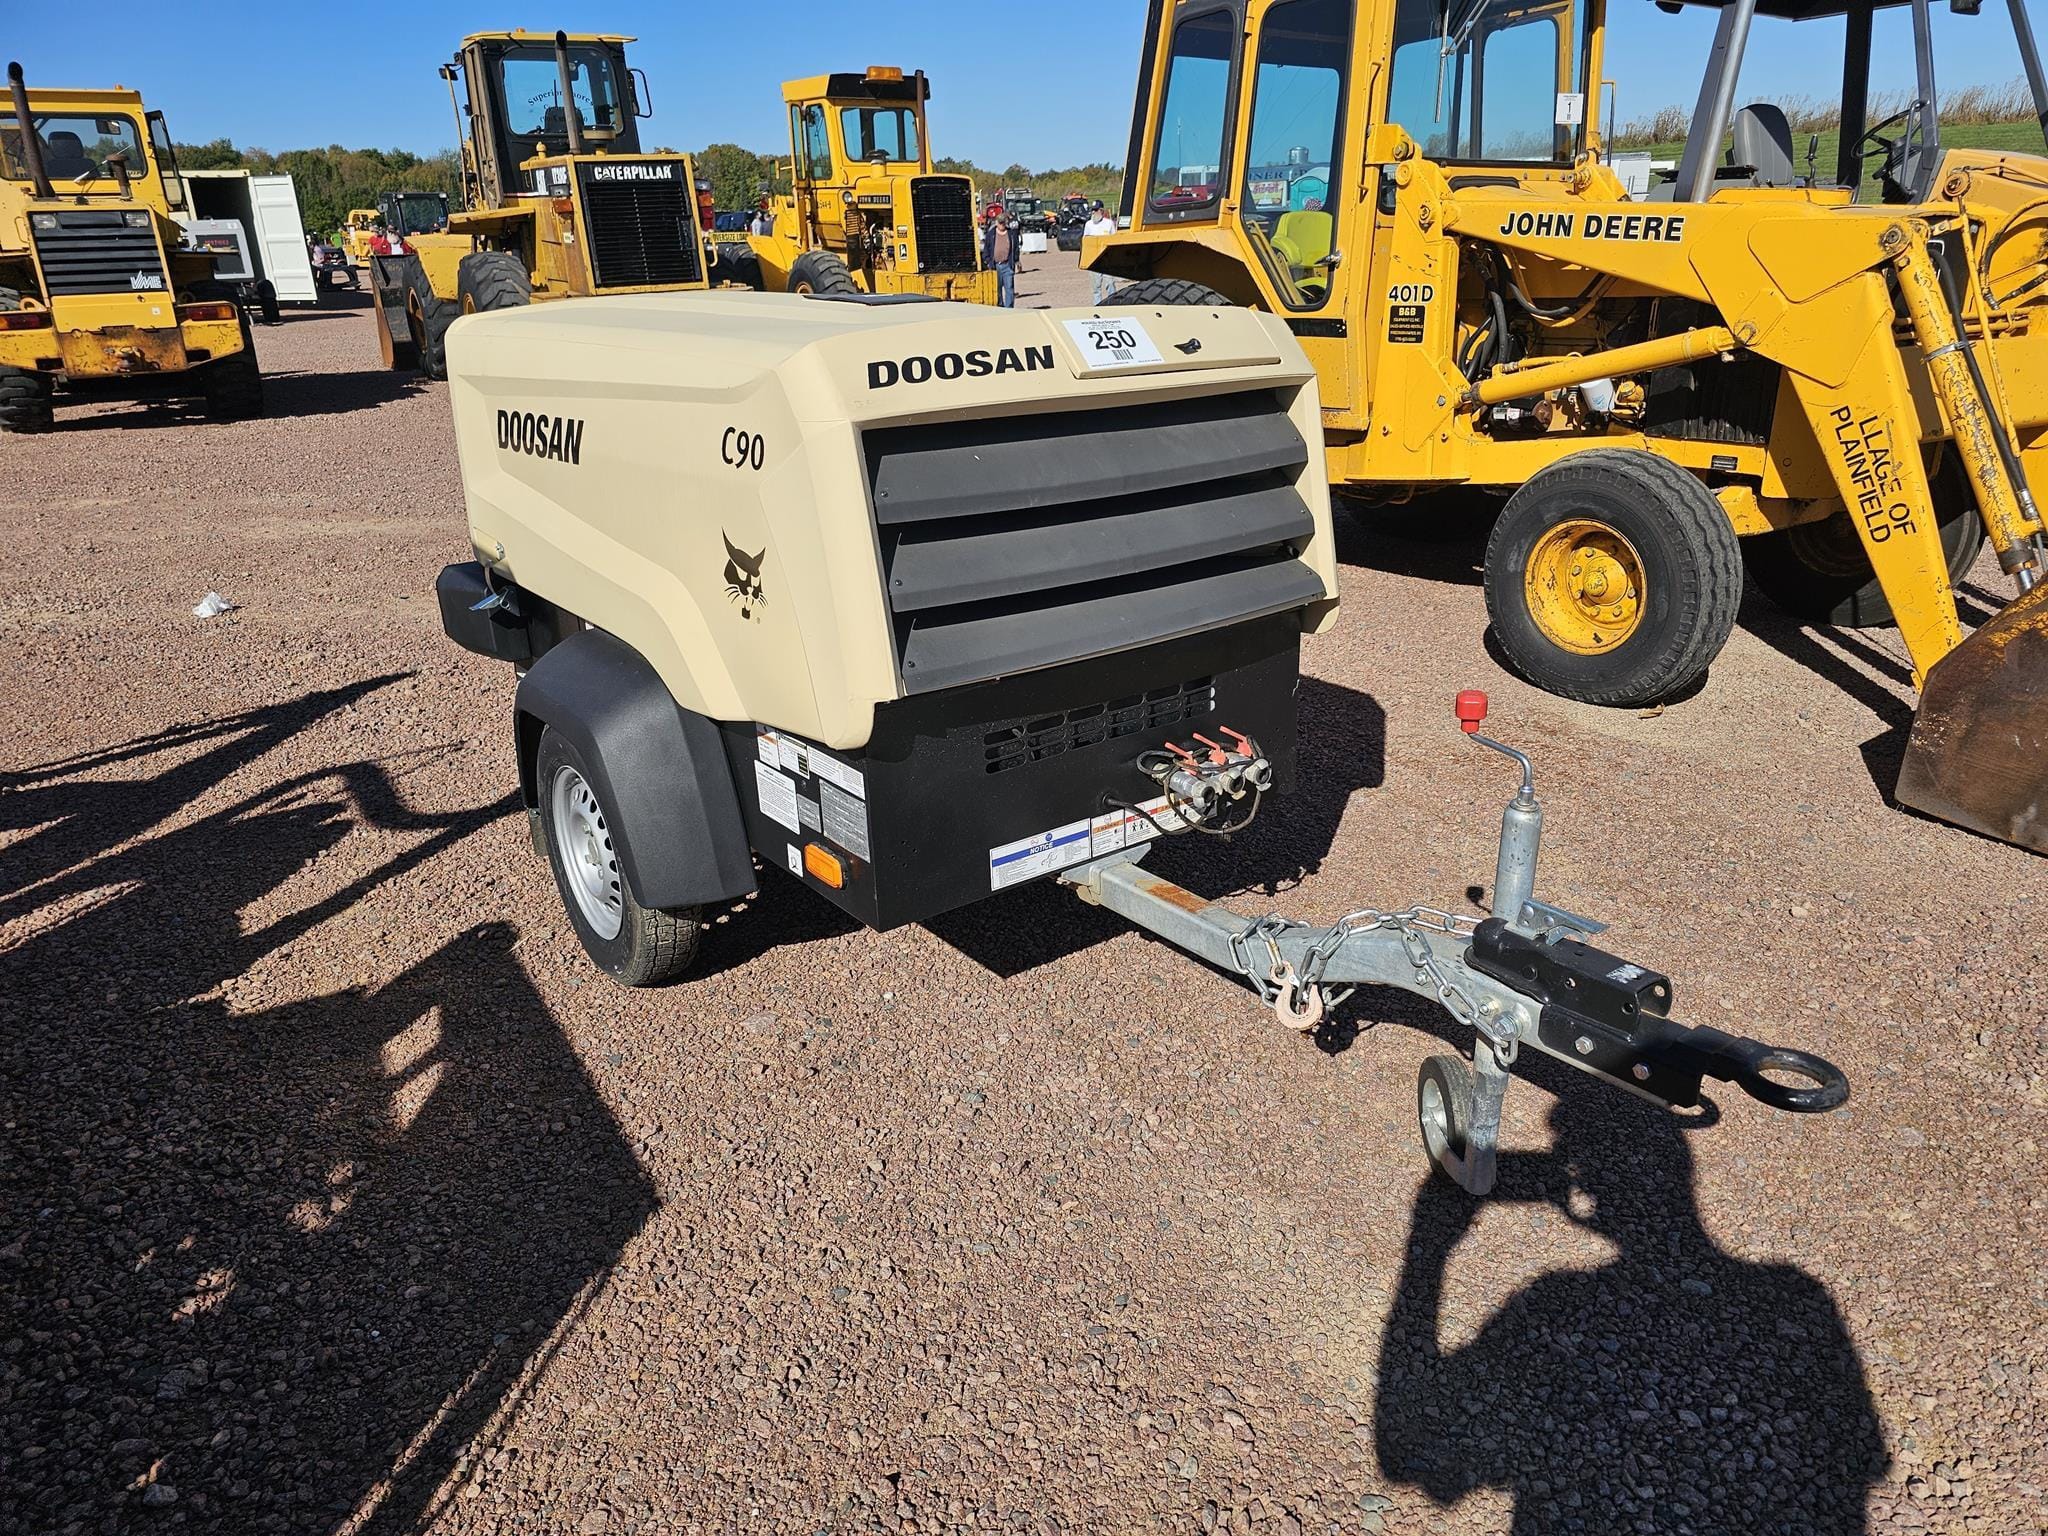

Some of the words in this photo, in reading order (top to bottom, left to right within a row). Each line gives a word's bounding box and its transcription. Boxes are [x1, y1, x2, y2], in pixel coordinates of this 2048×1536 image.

[1567, 102, 1571, 113] 1
[594, 165, 672, 180] CATERPILLAR
[1500, 213, 1574, 237] JOHN
[1583, 215, 1685, 242] DEERE
[130, 270, 162, 290] VME
[1389, 285, 1433, 302] 401D
[1398, 307, 1416, 316] B&B
[1088, 329, 1137, 350] 250
[867, 345, 1055, 389] DOOSAN
[497, 409, 584, 465] DOOSAN
[722, 426, 765, 471] C90
[1830, 405, 1891, 543] PLAINFIELD
[1888, 503, 1917, 535] OF
[1030, 841, 1054, 855] NOTICE
